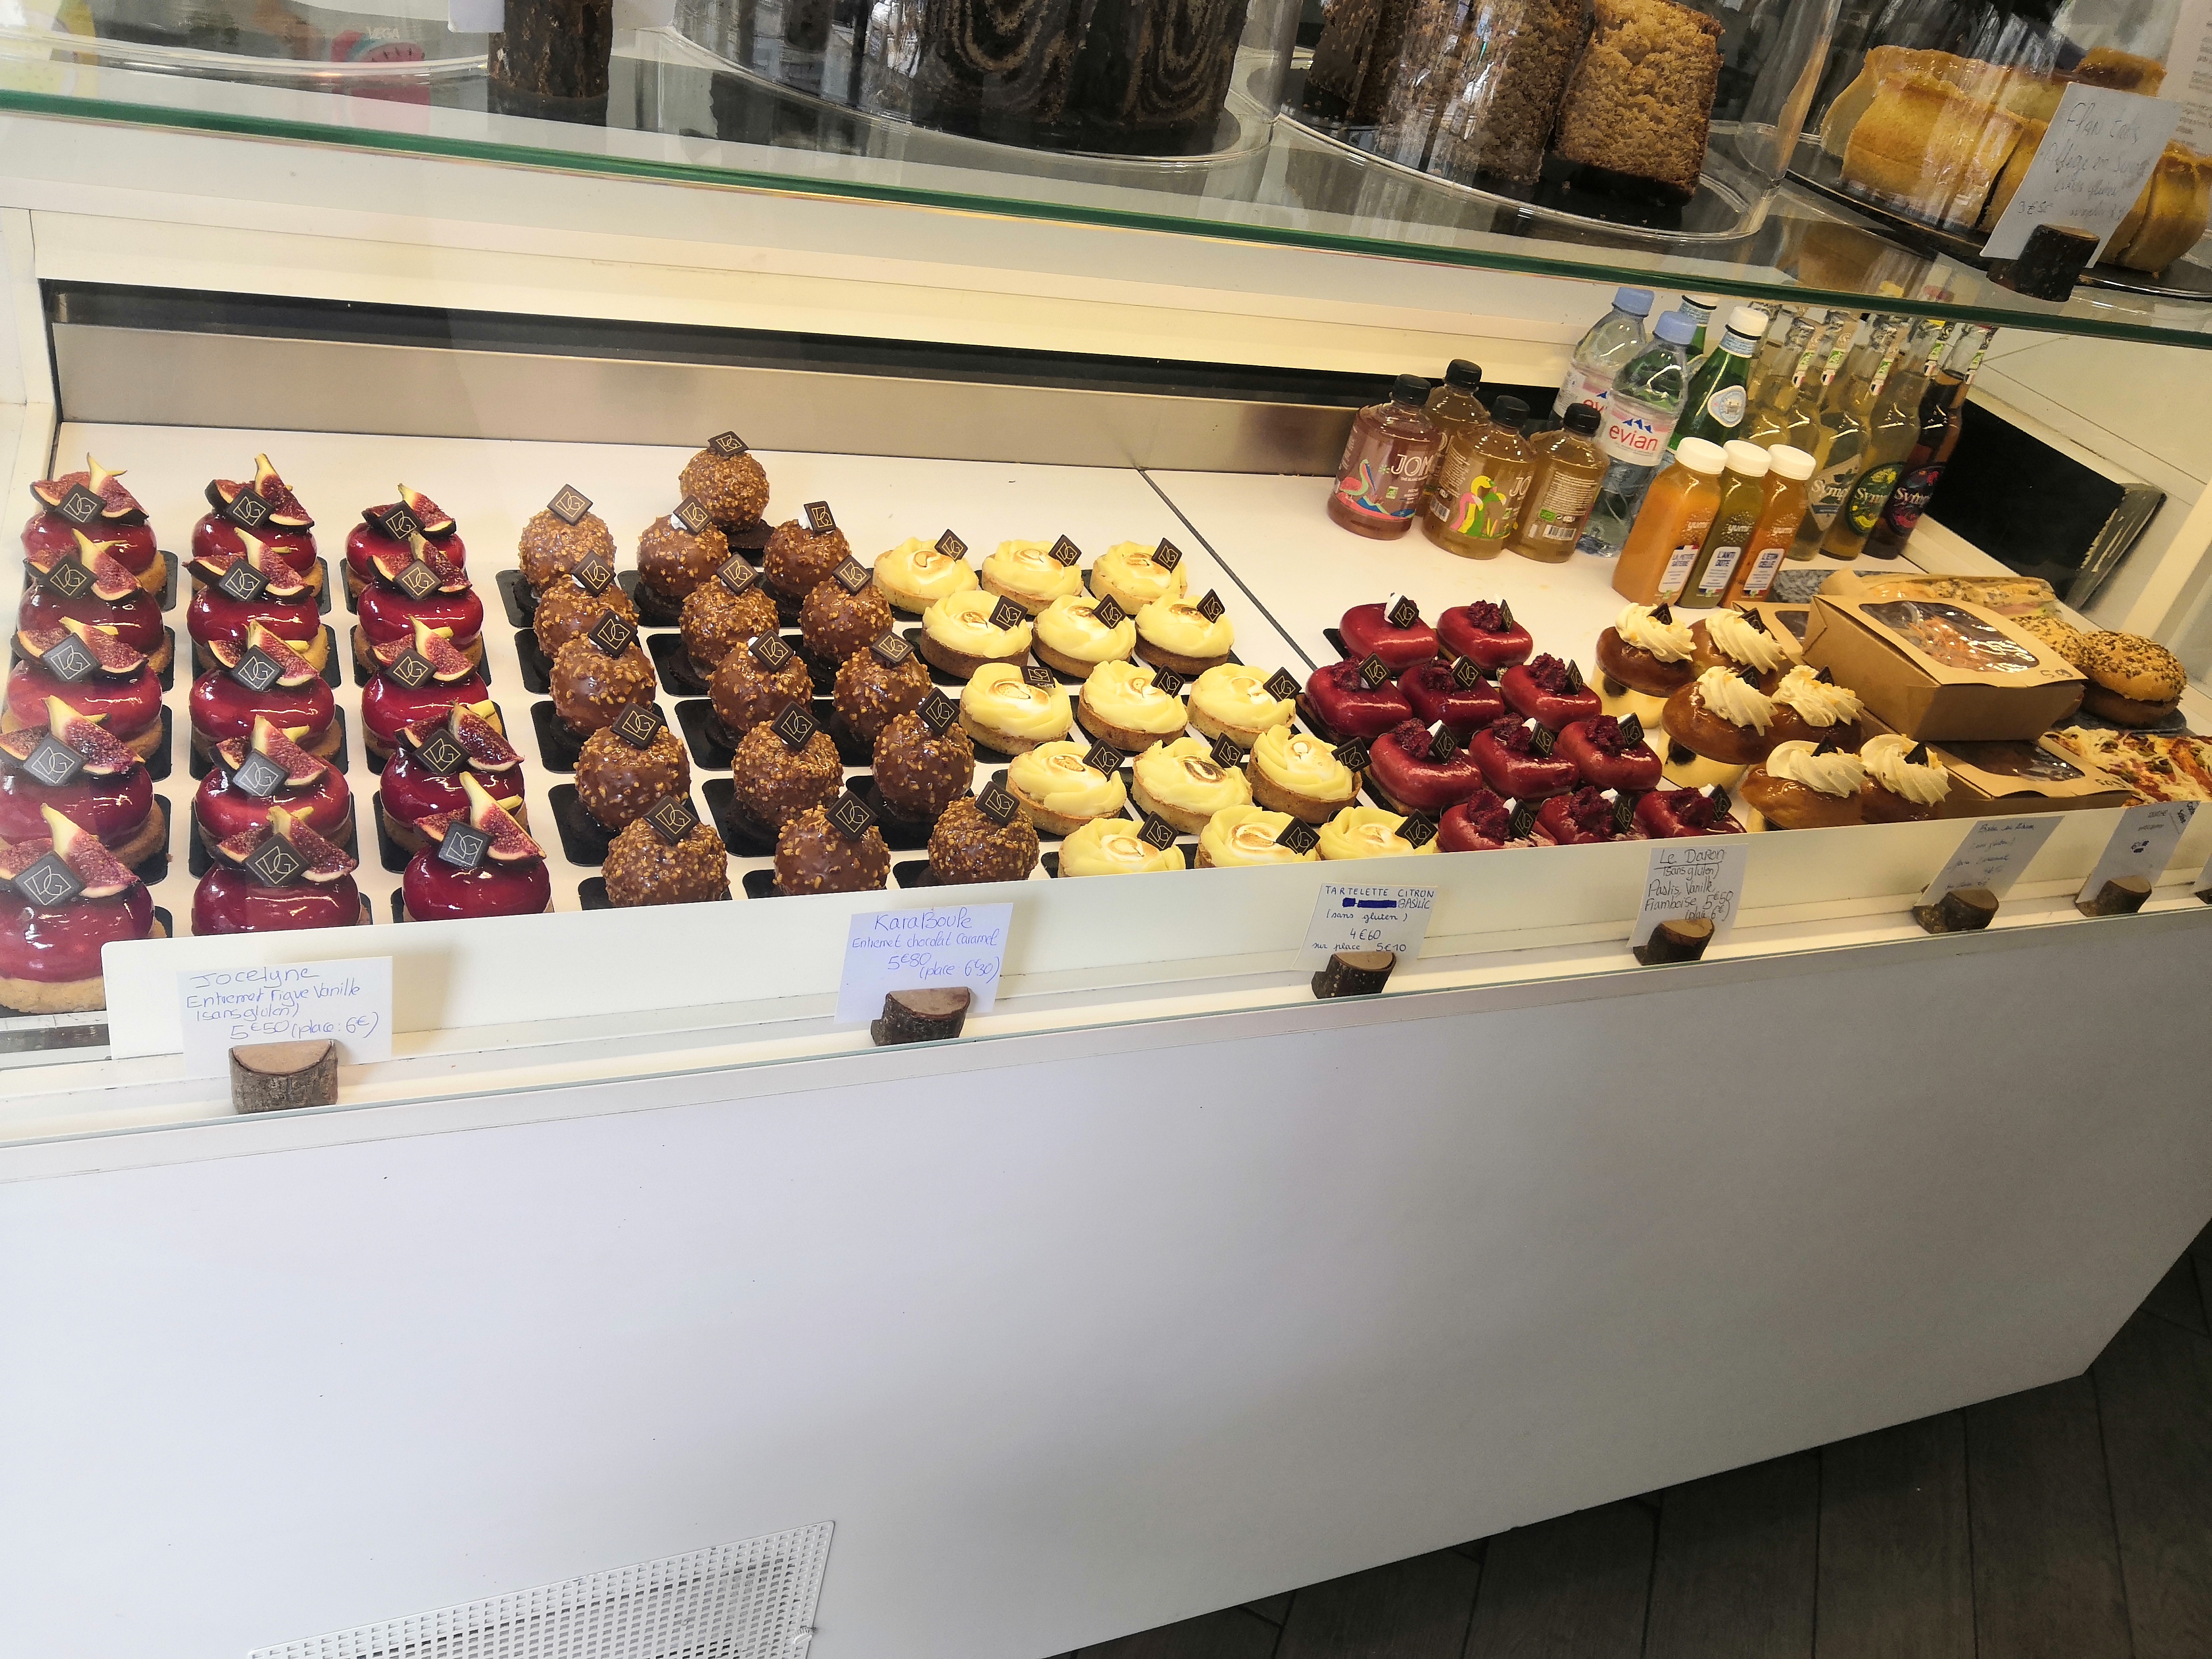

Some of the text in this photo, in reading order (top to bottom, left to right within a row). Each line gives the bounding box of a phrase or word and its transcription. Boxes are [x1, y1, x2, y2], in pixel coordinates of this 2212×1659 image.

[1609, 425, 1659, 451] evian
[1659, 848, 1677, 865] Le
[1325, 885, 1434, 898] TARTELETTE CITRON
[1326, 908, 1354, 919] (sans
[852, 937, 902, 949] Entremet
[906, 930, 952, 948] chocolat
[1333, 942, 1361, 952] place
[189, 966, 320, 988] Jocelyne
[186, 987, 264, 1009] Entremet
